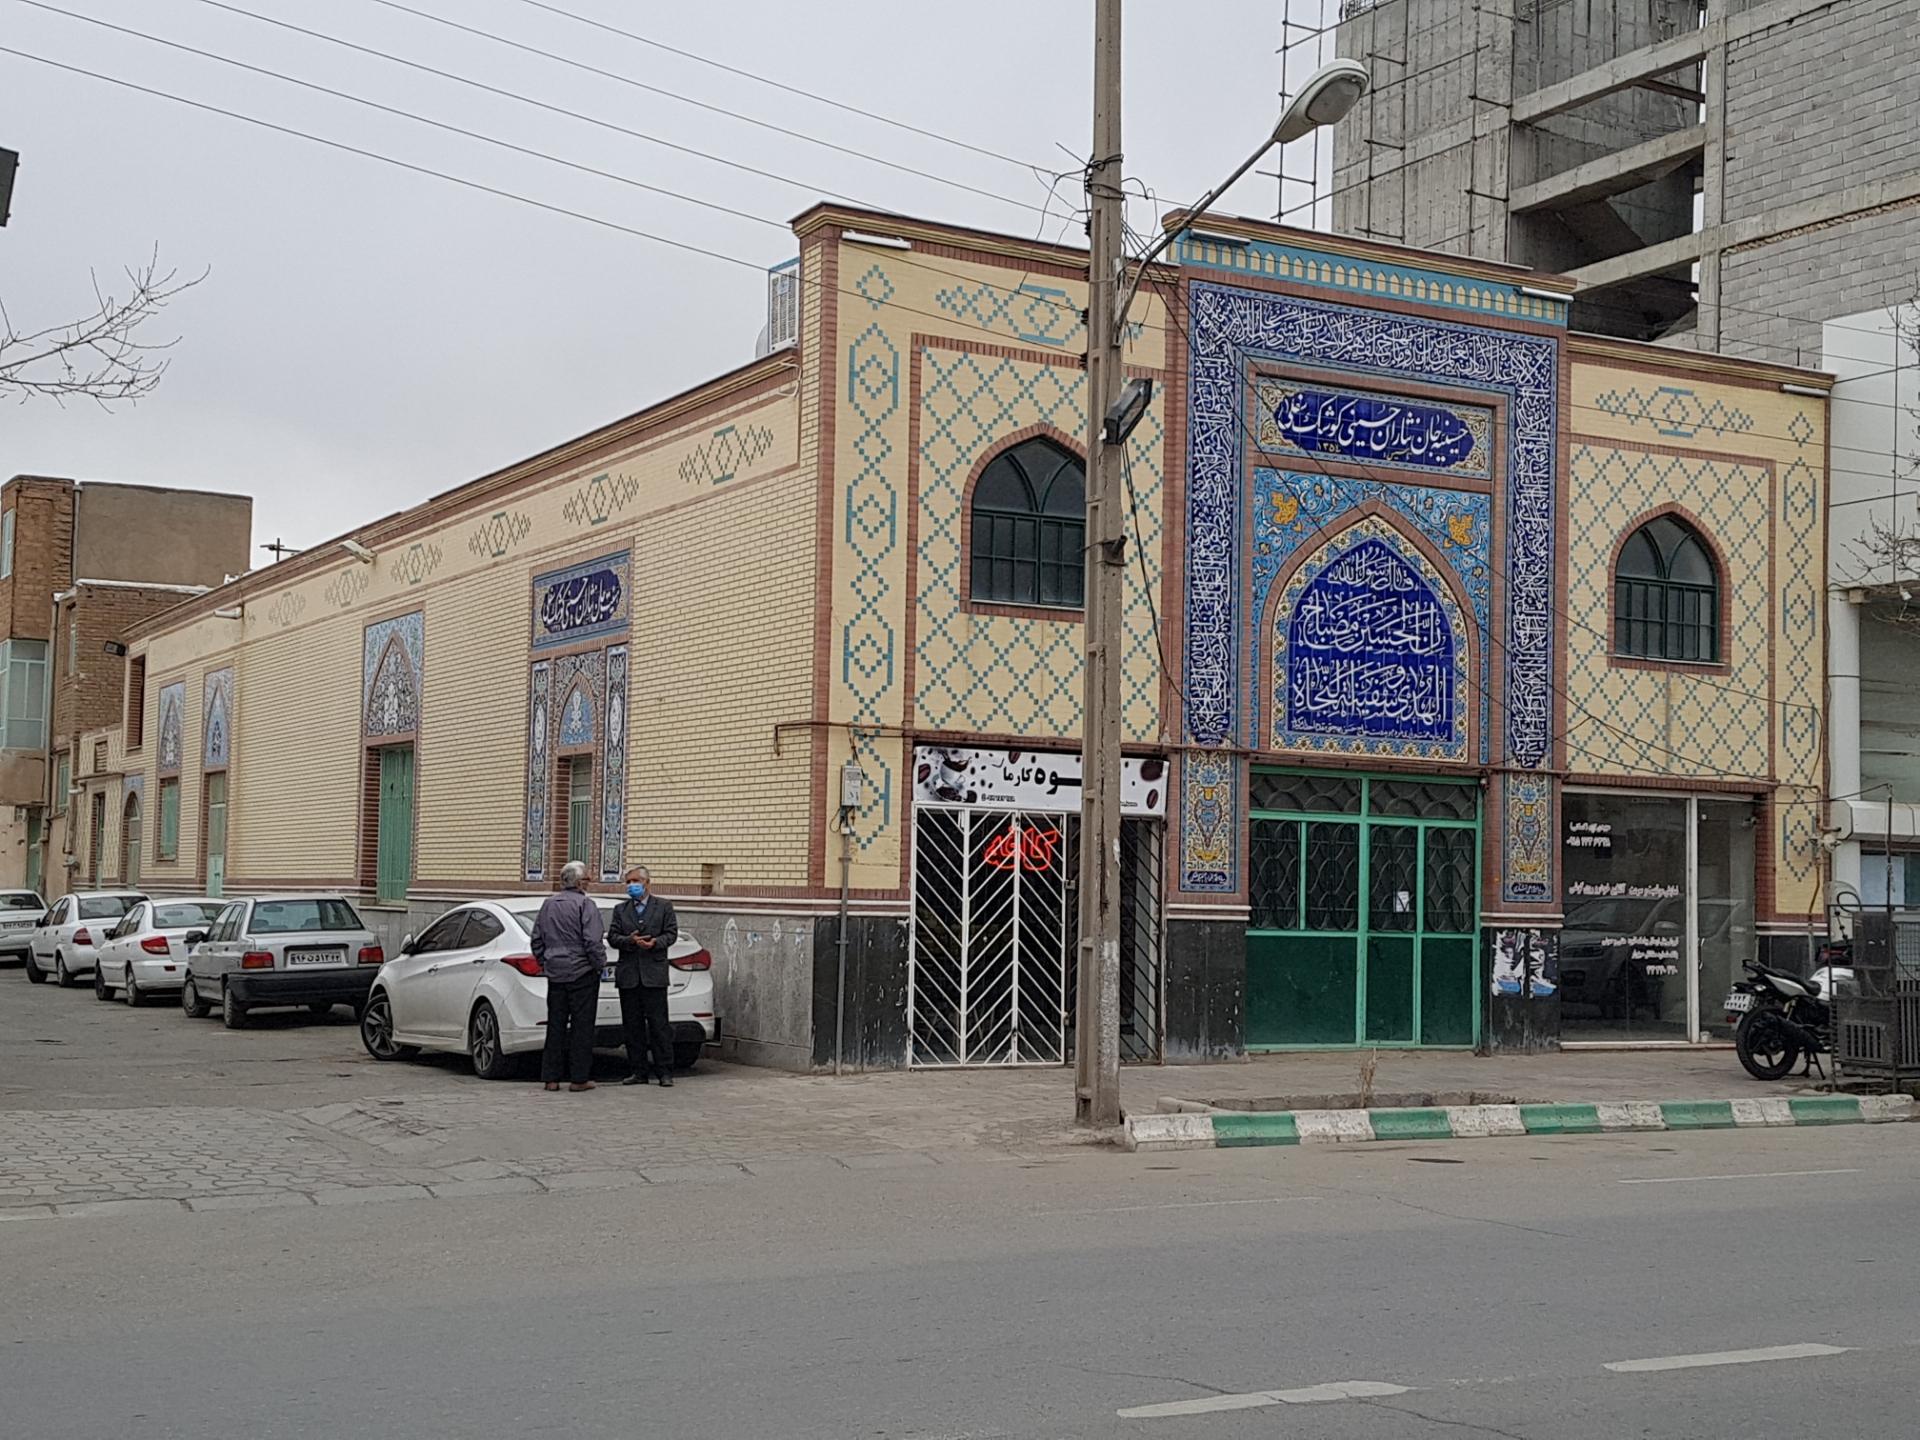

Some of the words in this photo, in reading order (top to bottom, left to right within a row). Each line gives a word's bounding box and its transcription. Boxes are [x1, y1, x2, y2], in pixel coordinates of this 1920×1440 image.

[1338, 404, 1402, 447] حسینی
[1410, 414, 1442, 456] جان
[560, 577, 589, 630] حسینی
[1003, 766, 1033, 787] کارما
